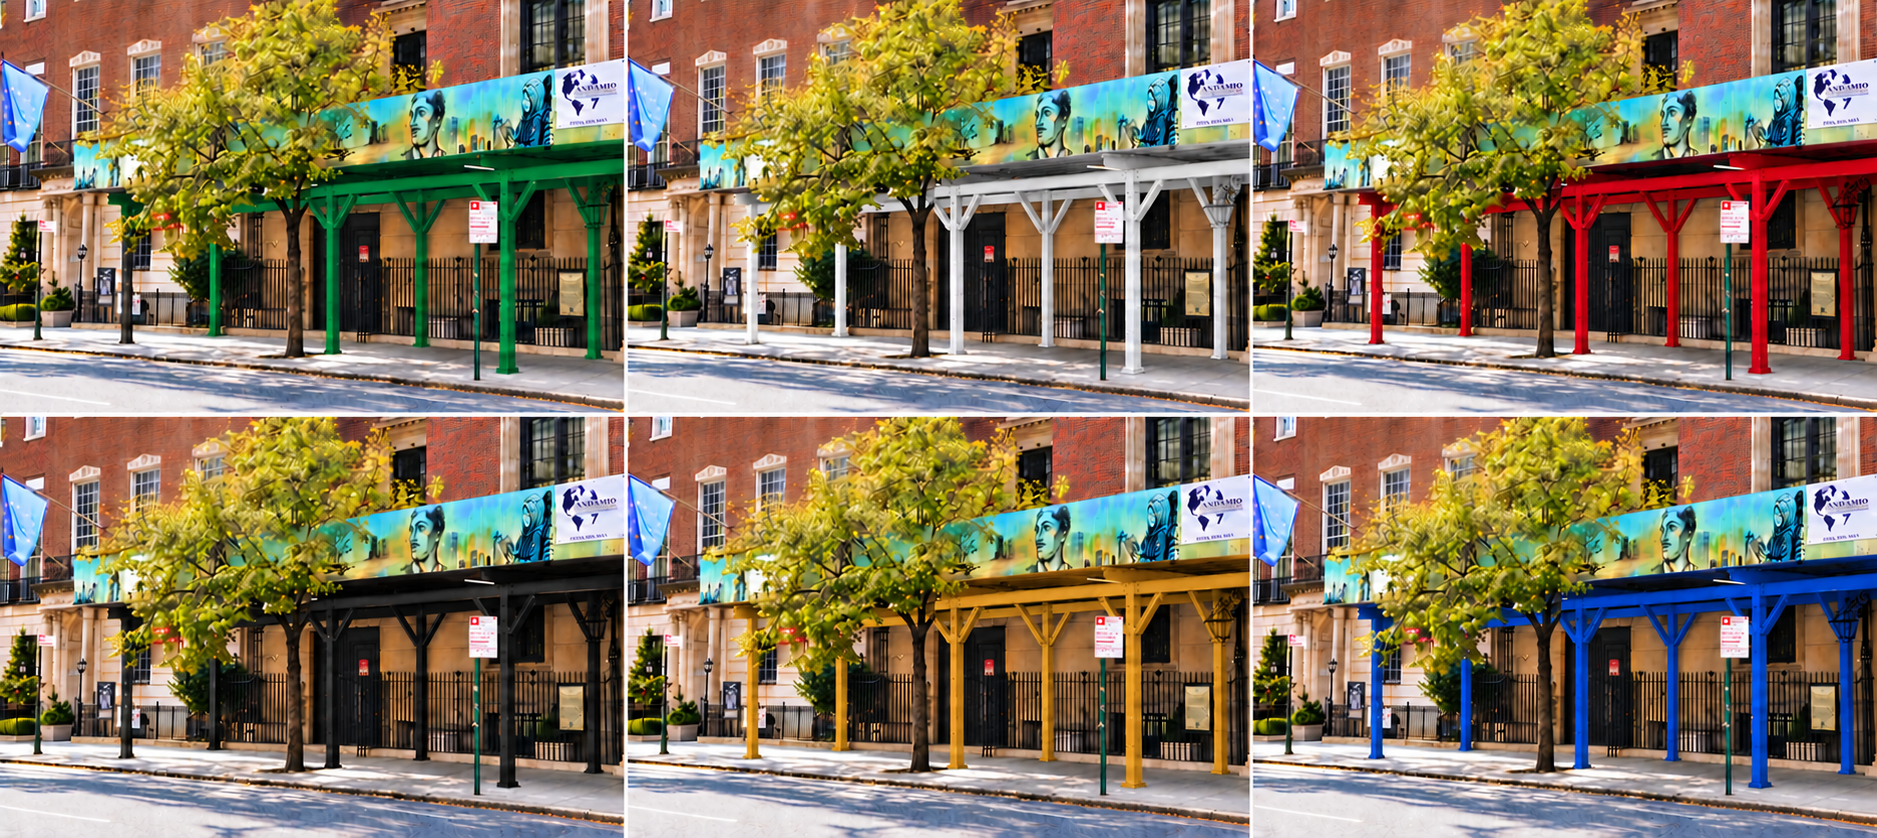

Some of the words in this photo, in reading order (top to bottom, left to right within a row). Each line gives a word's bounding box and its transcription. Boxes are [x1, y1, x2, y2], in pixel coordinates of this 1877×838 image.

[591, 97, 600, 109] 7
[1216, 97, 1225, 110] 7
[1842, 97, 1852, 110] 7
[591, 513, 599, 525] 7
[1216, 513, 1224, 525] 7
[1842, 513, 1851, 525] 7
